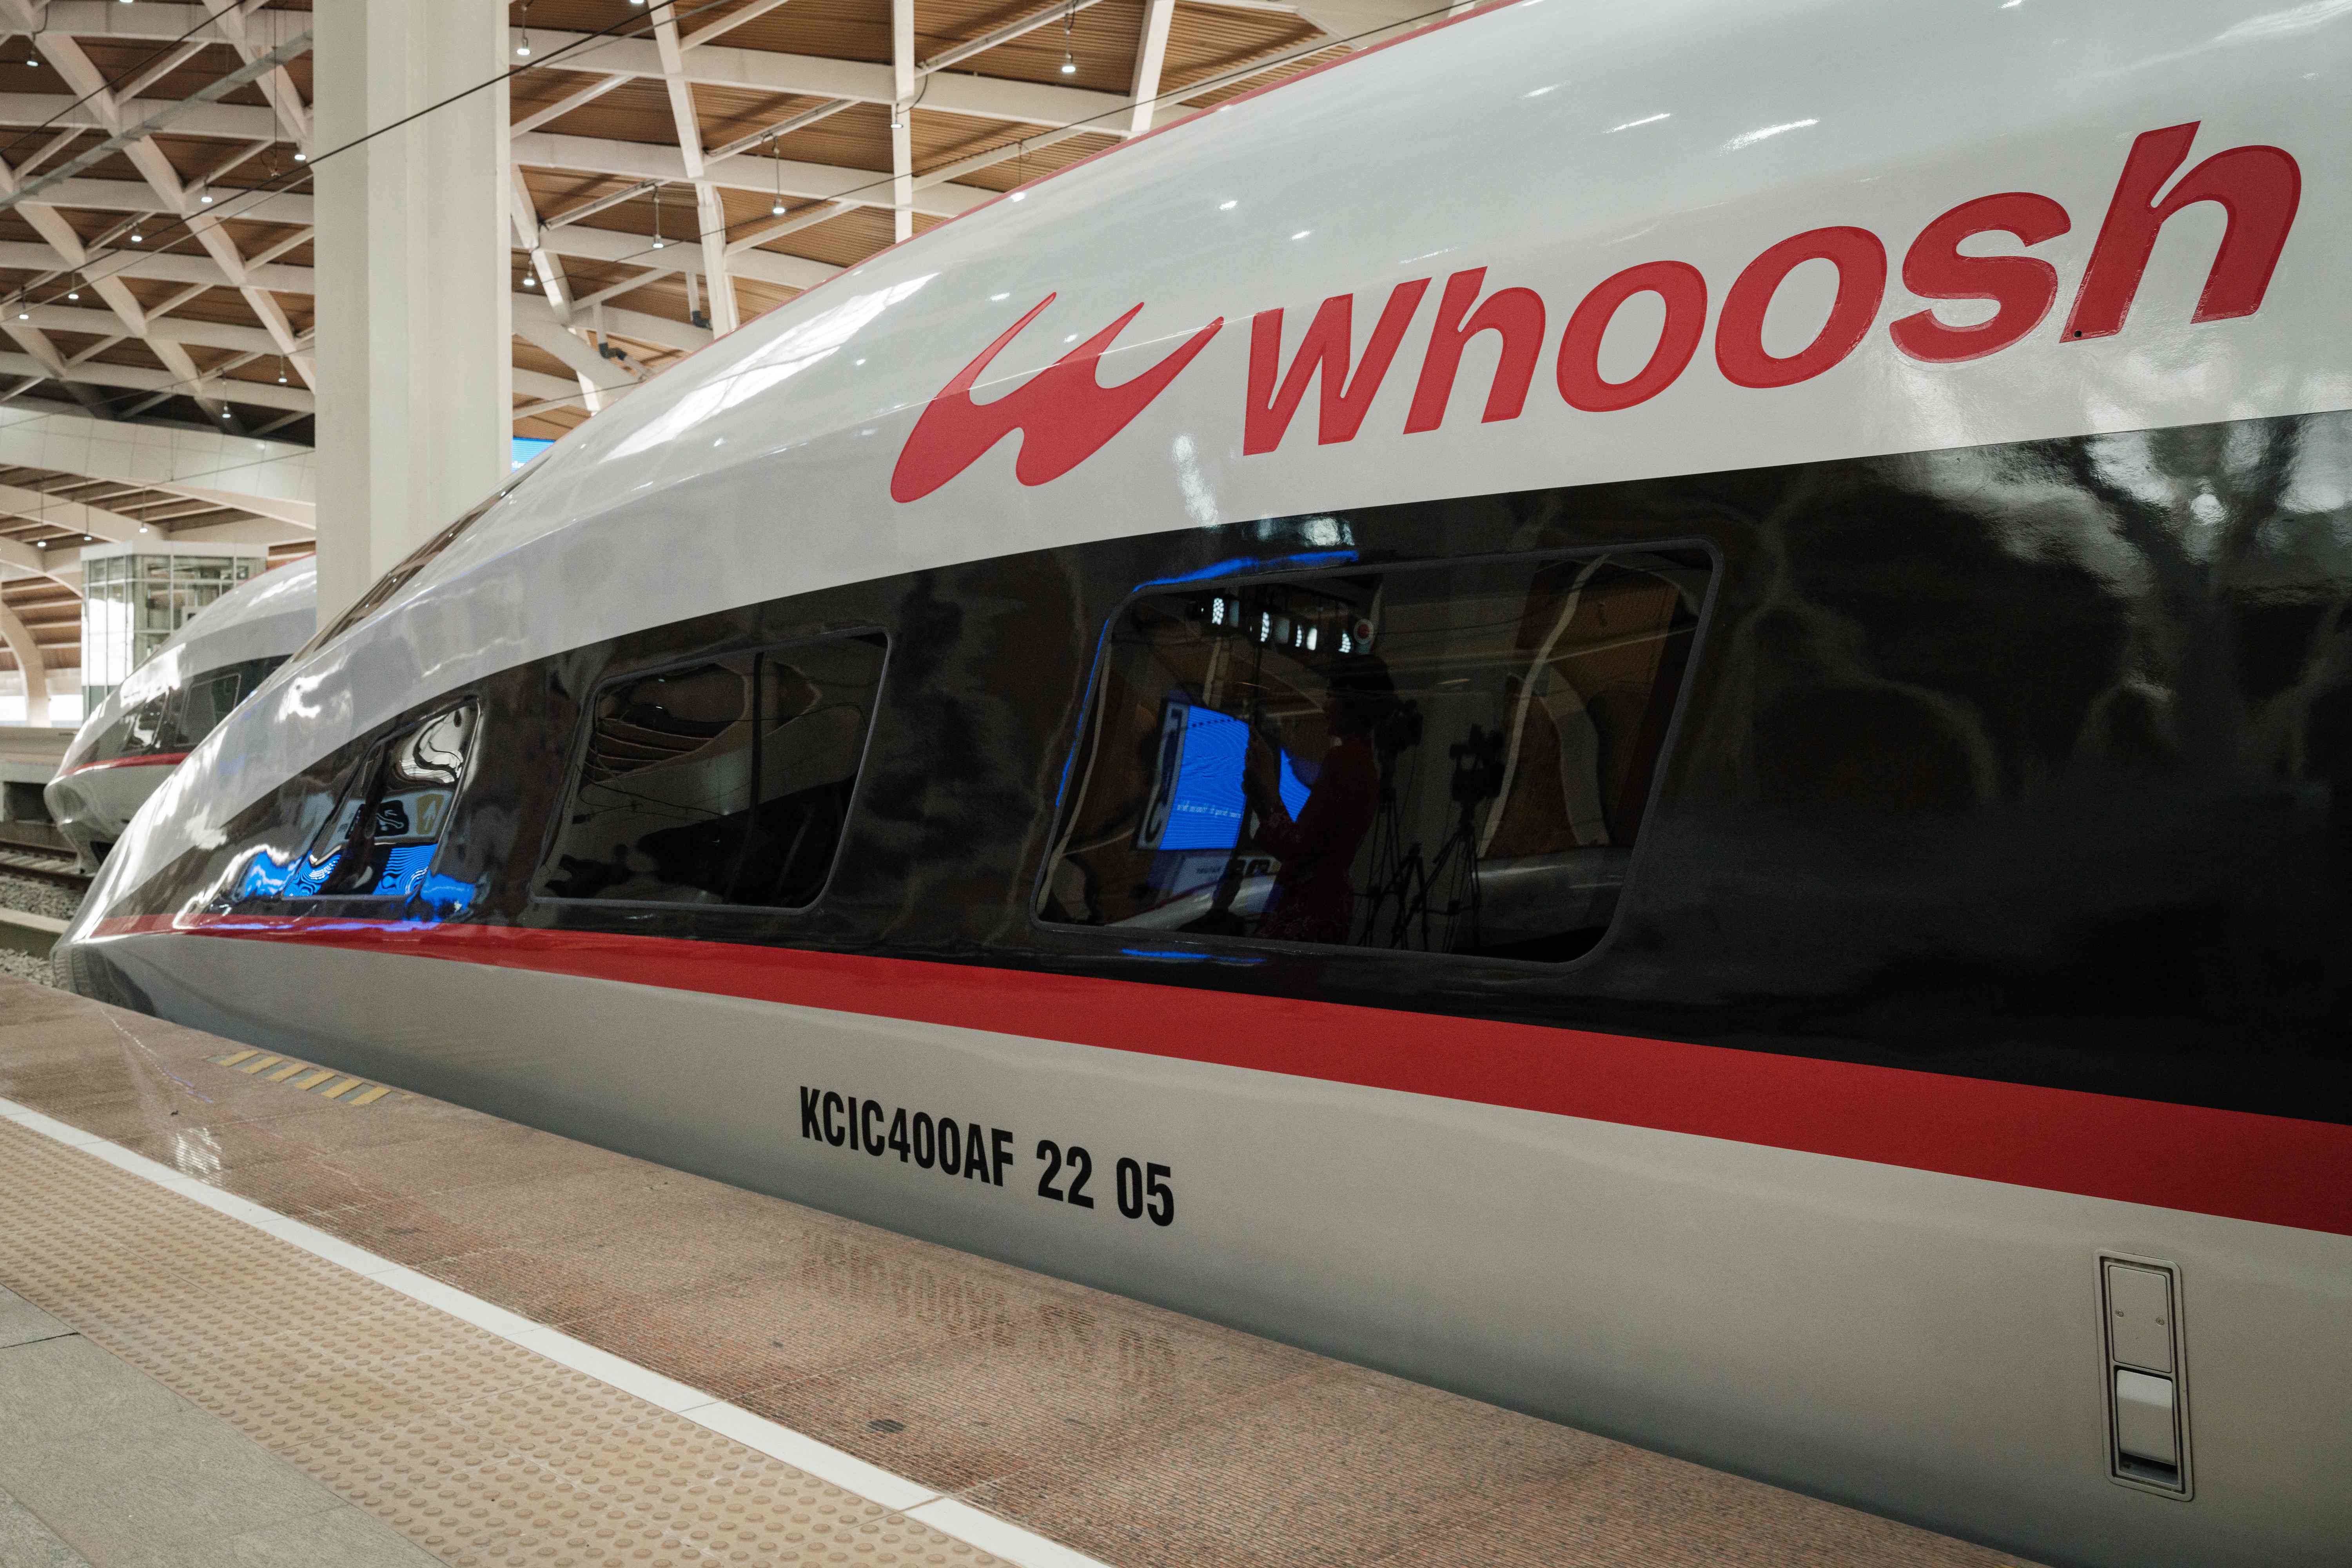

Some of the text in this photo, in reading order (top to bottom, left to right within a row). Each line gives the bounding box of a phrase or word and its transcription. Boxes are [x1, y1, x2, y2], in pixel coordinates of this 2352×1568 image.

[800, 1085, 1174, 1227] KCIC400AF 22 05
